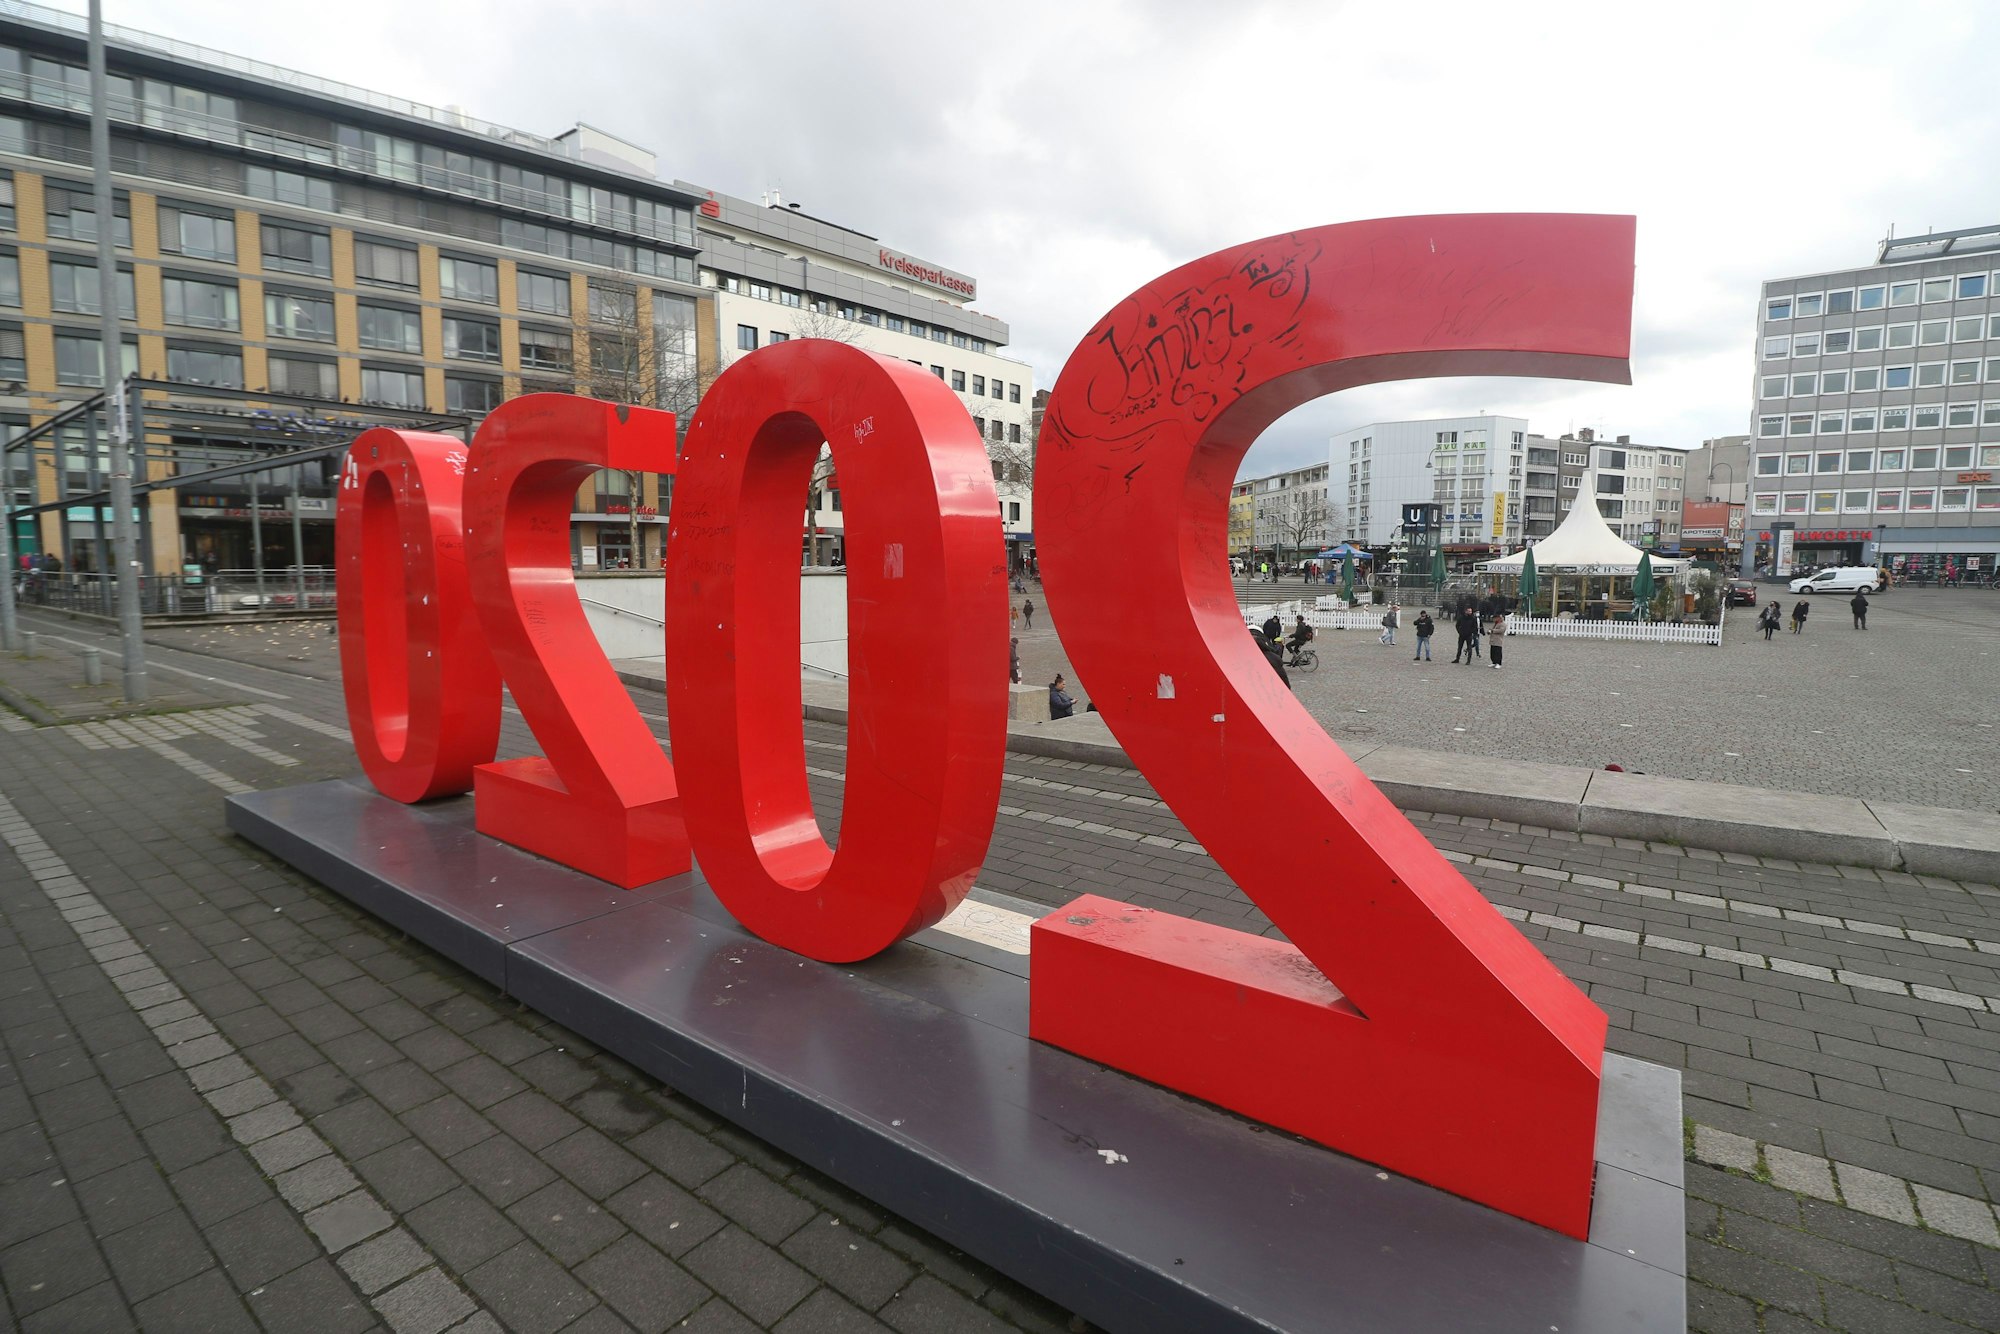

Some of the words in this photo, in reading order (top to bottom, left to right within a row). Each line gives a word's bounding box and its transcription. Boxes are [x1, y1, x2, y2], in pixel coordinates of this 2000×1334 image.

[879, 249, 975, 295] Kreissparkasse
[1957, 472, 1992, 483] DAK
[1410, 508, 1420, 523] U
[1433, 509, 1438, 523] U
[1759, 531, 1872, 541] WLWORTH
